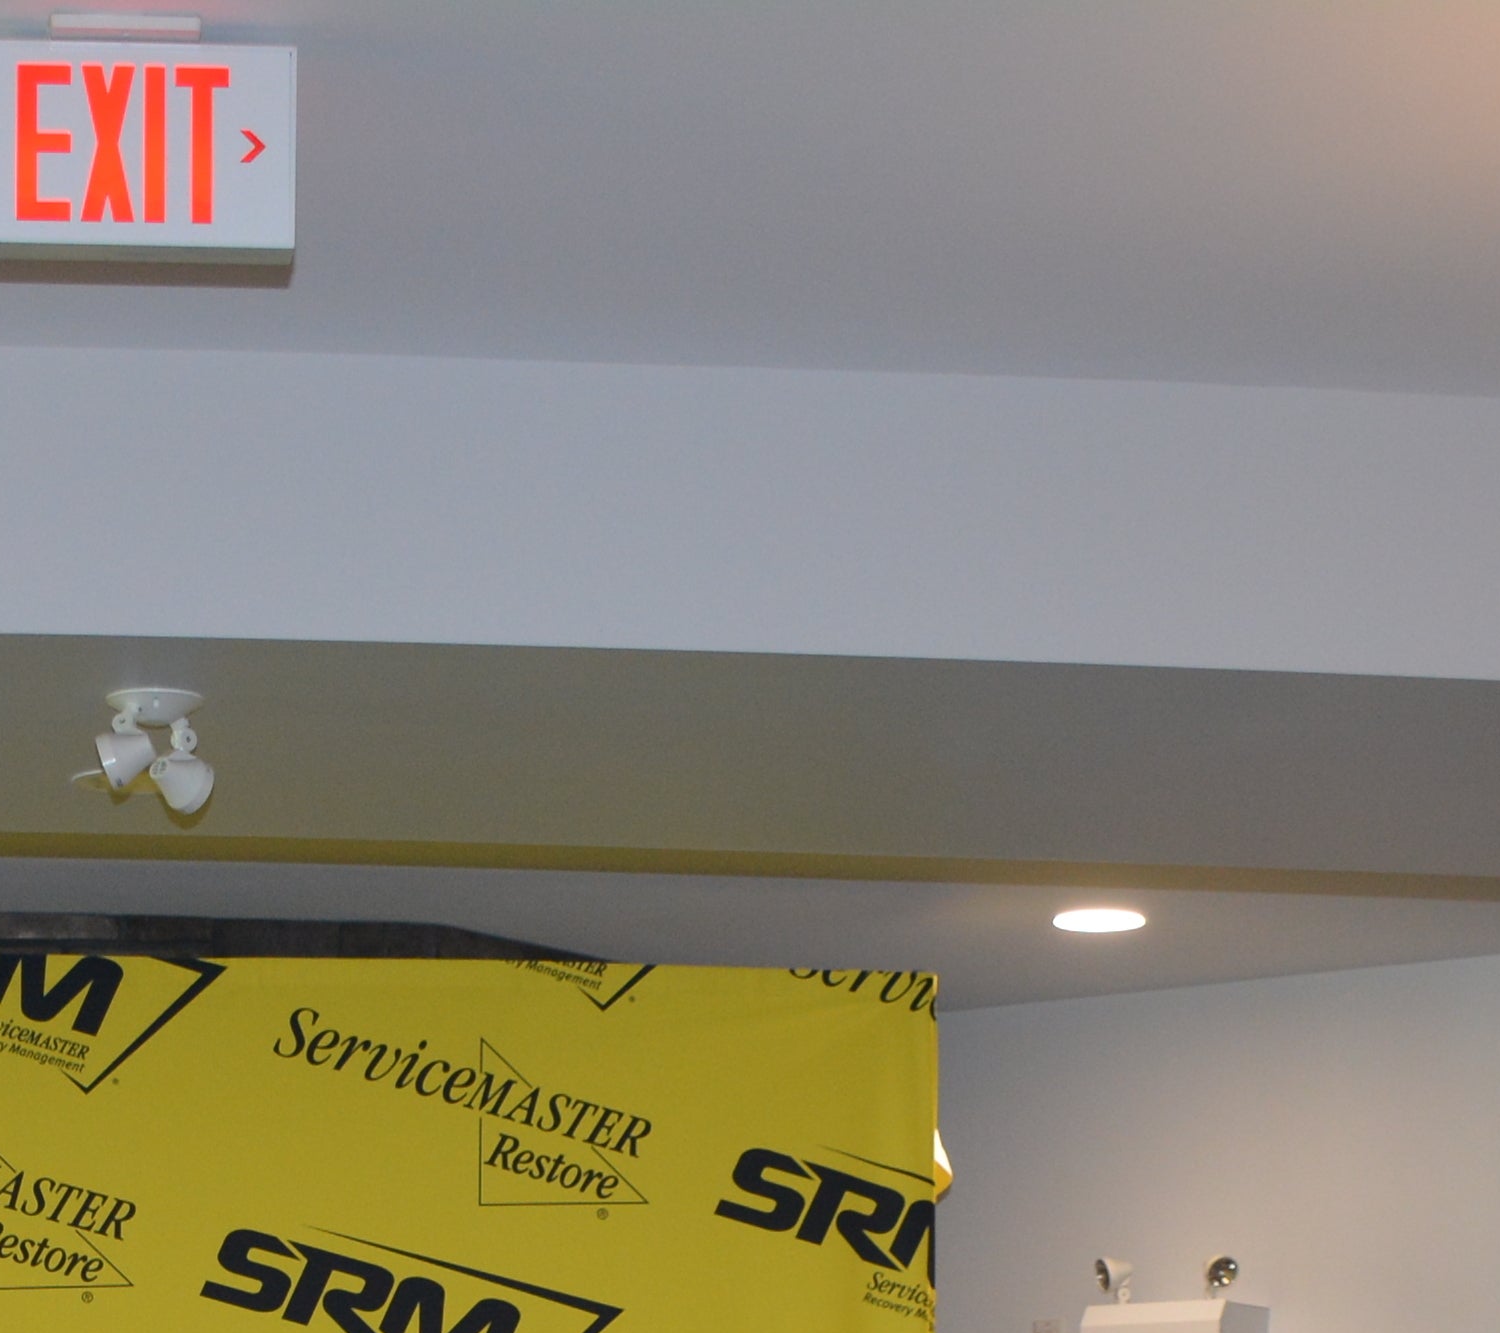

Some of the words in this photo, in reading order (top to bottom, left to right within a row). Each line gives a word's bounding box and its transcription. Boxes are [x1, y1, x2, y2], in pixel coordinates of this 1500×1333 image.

[15, 63, 229, 224] EXIT
[273, 1007, 652, 1158] ServiceMASTER
[484, 1133, 620, 1200] Restore
